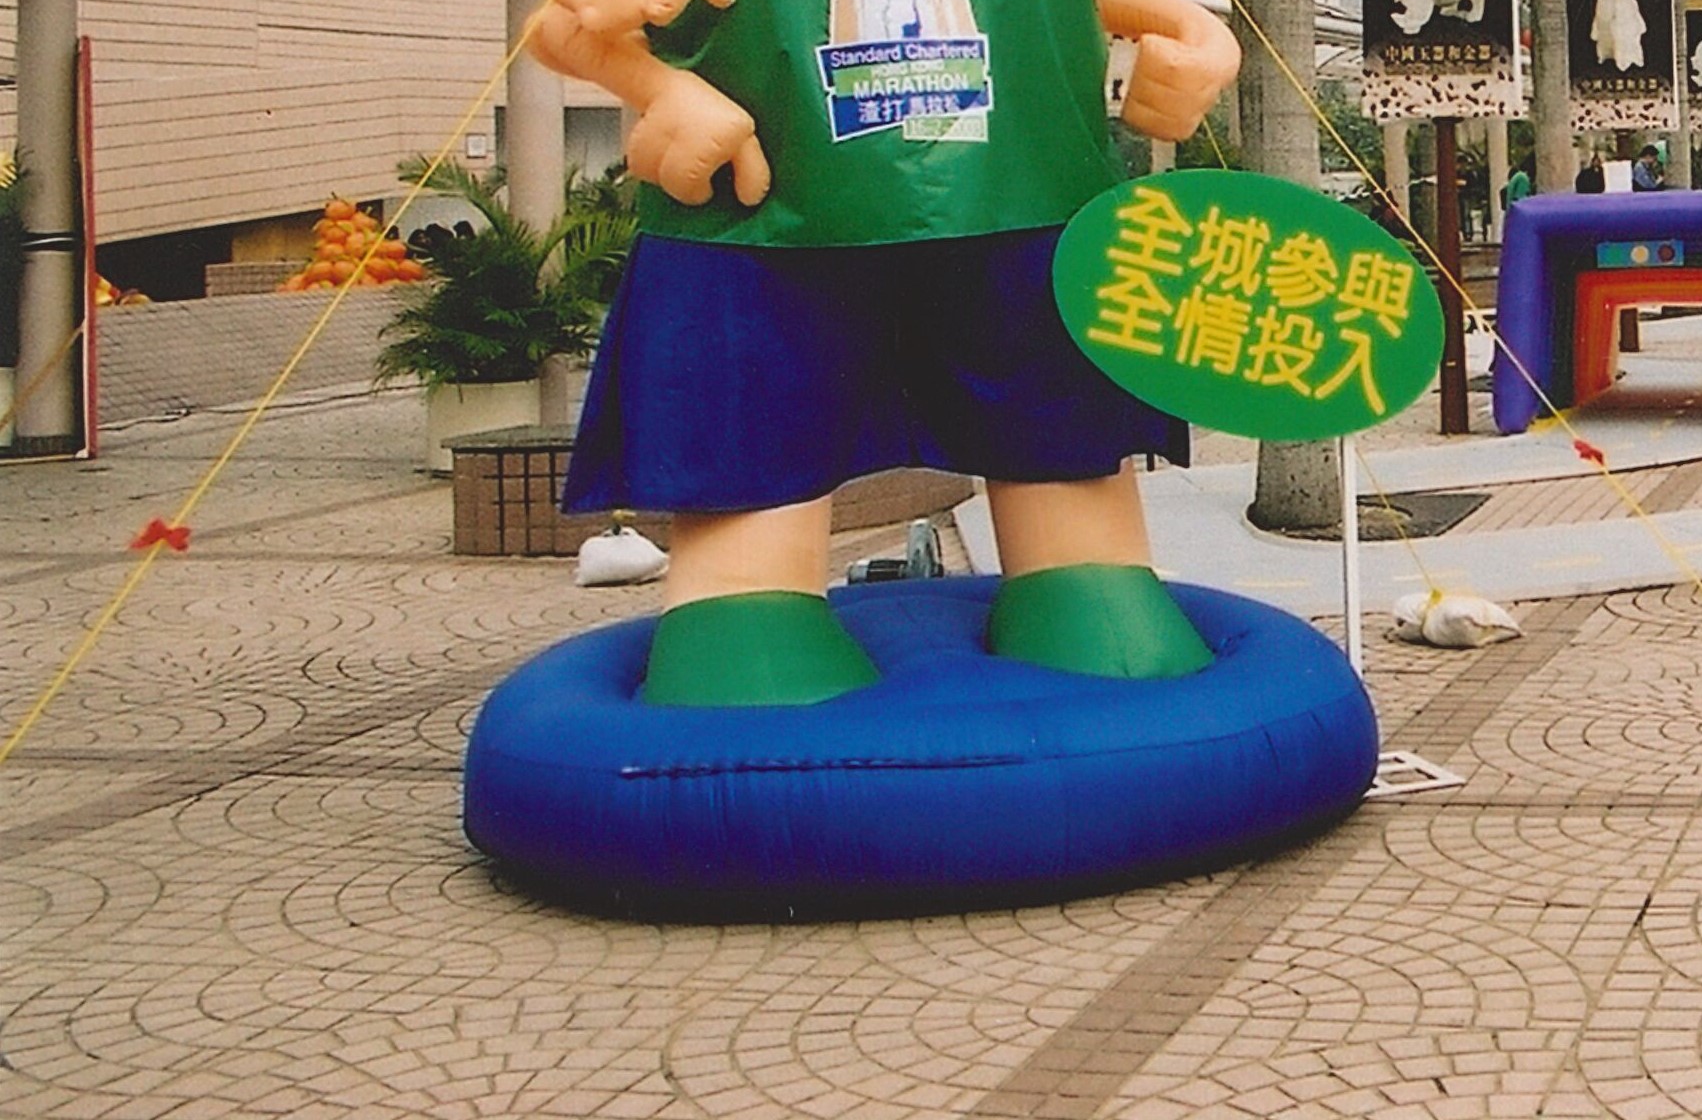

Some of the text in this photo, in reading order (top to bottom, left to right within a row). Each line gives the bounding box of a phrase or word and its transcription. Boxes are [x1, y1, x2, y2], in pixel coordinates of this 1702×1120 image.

[830, 43, 980, 67] Standard Chartered
[853, 73, 969, 99] MARATHON
[1107, 186, 1414, 339] 全城參與
[1087, 264, 1387, 416] 全情投入
